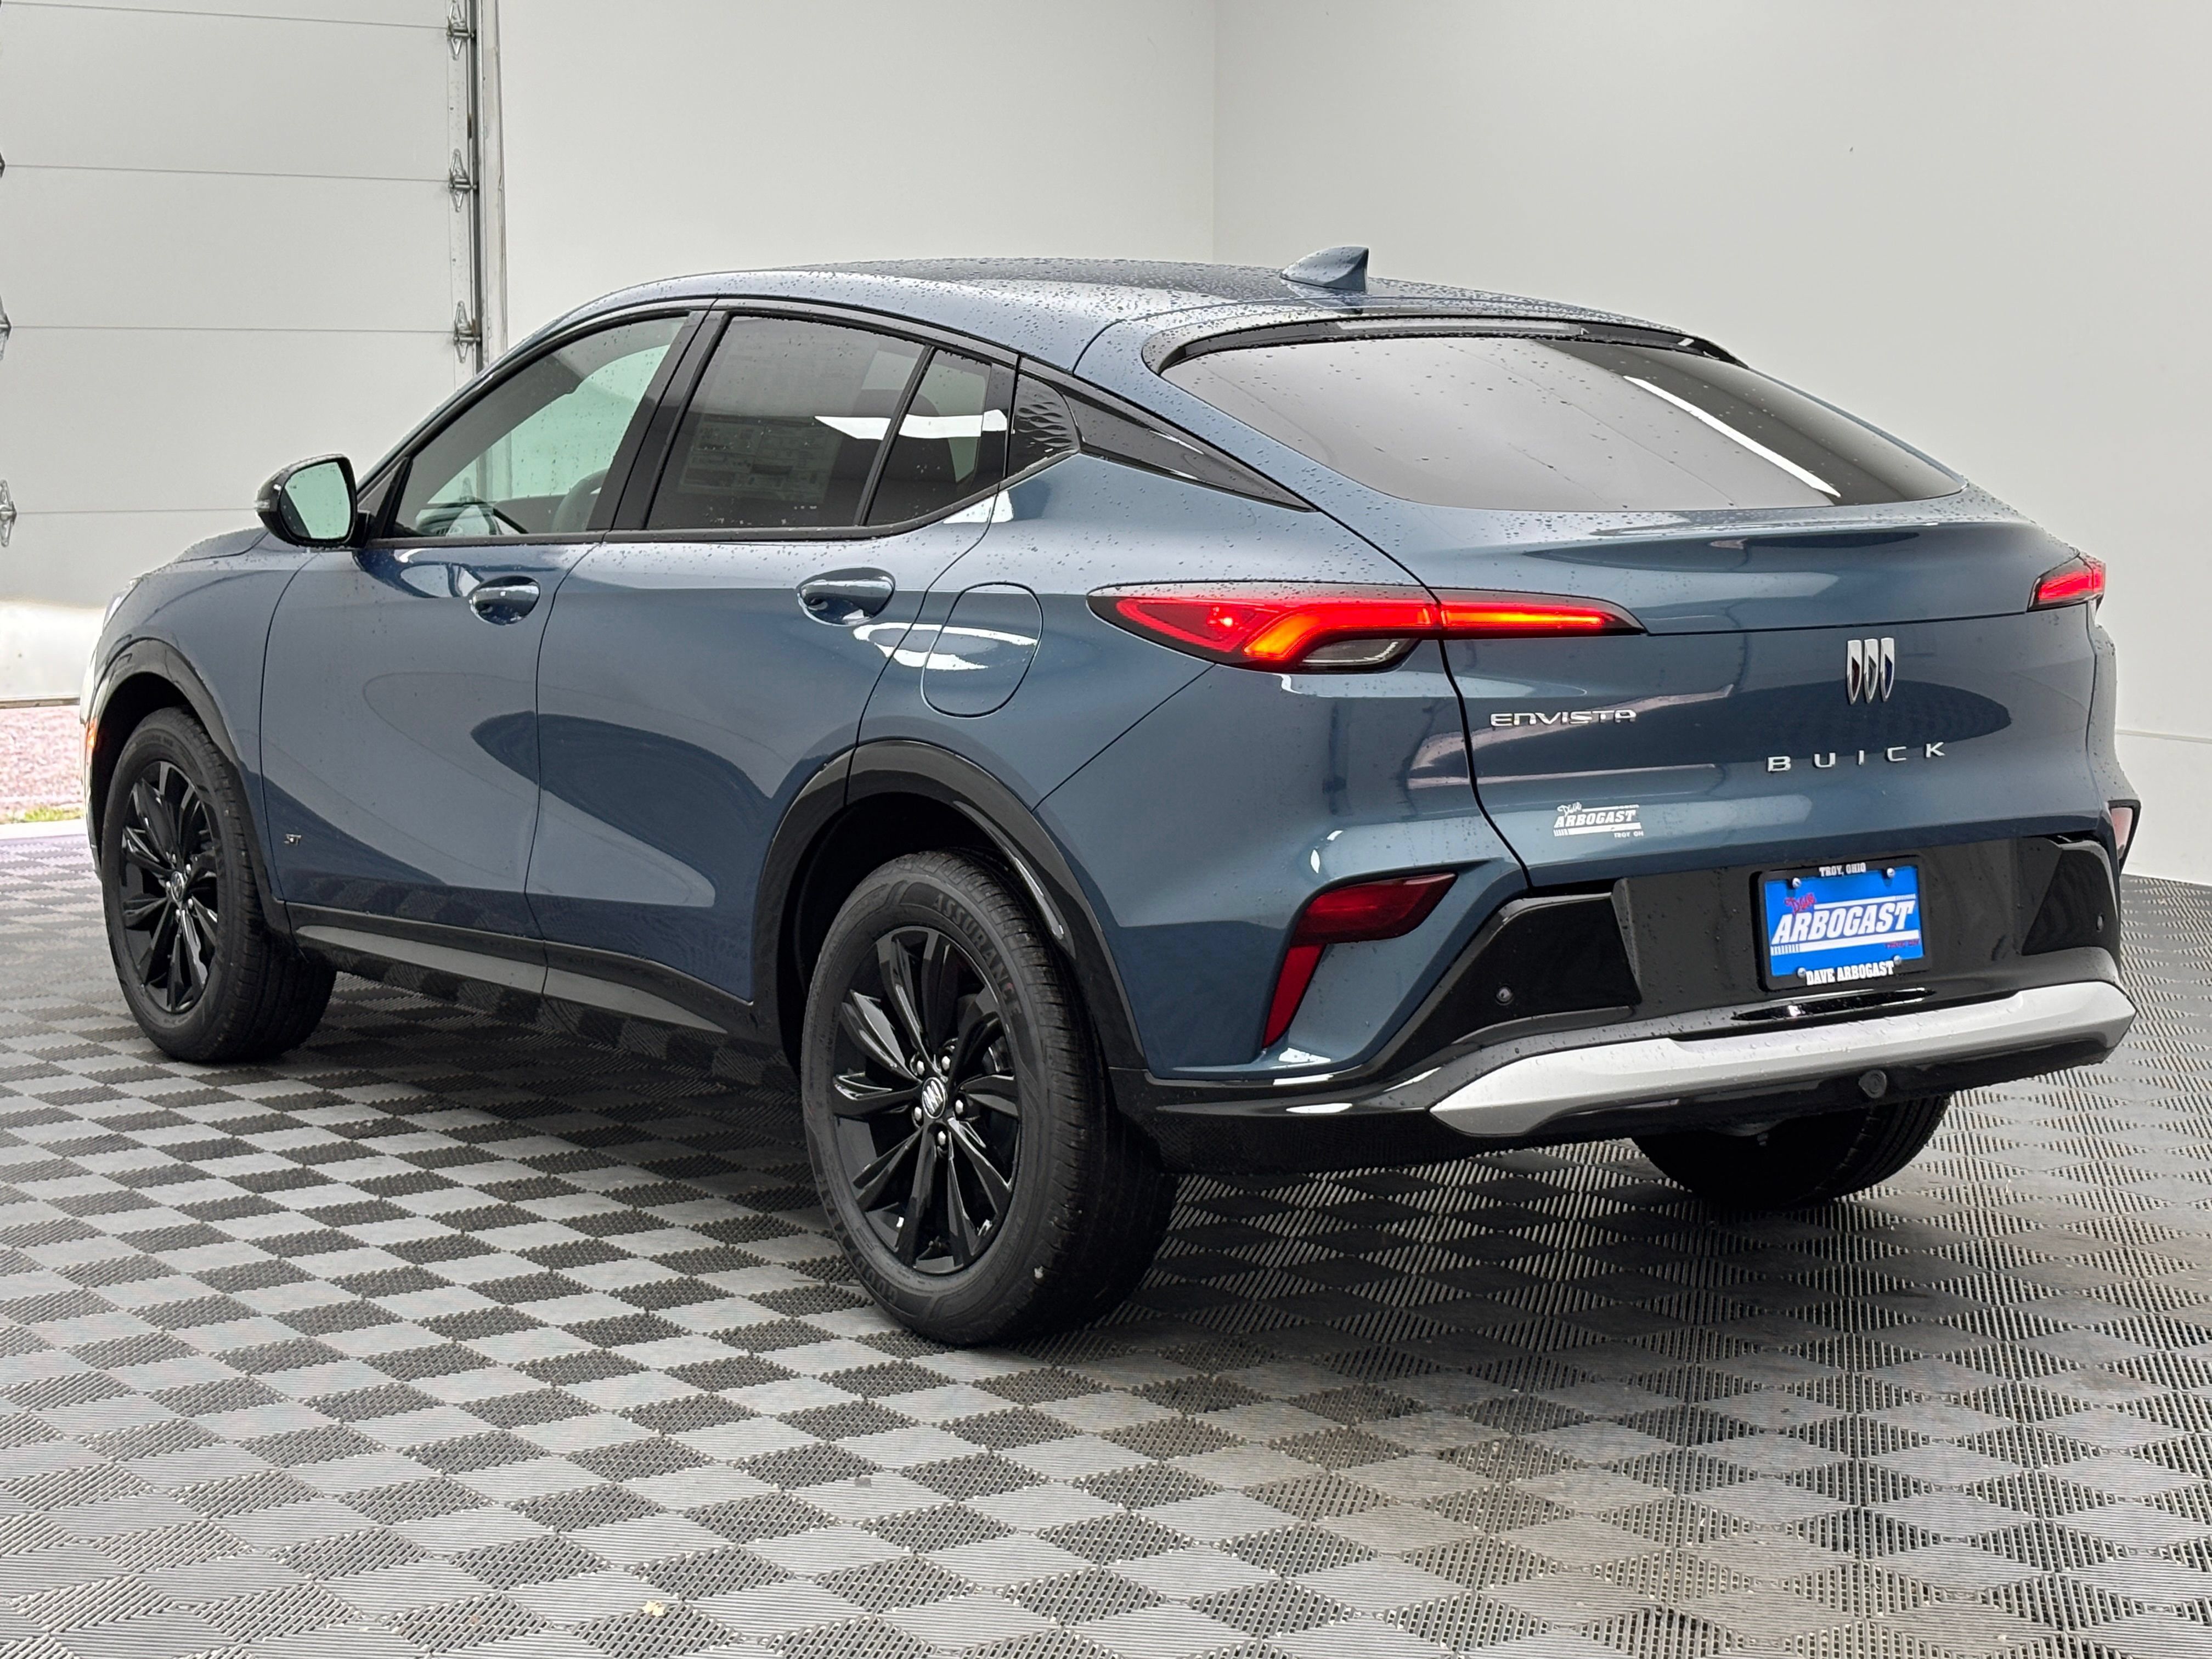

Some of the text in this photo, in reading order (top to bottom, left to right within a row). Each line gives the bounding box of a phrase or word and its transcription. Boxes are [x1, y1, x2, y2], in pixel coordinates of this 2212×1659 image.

[1491, 709, 1637, 727] ENVISTA
[1767, 742, 1945, 772] BUICK
[1554, 810, 1636, 828] ARBOGAST
[1819, 862, 1866, 877] TROY, OHIO
[1771, 900, 1916, 945] ARBOGAST
[932, 893, 1023, 1015] ASSURANCE
[1806, 960, 1894, 986] DAVE ARBOGAST
